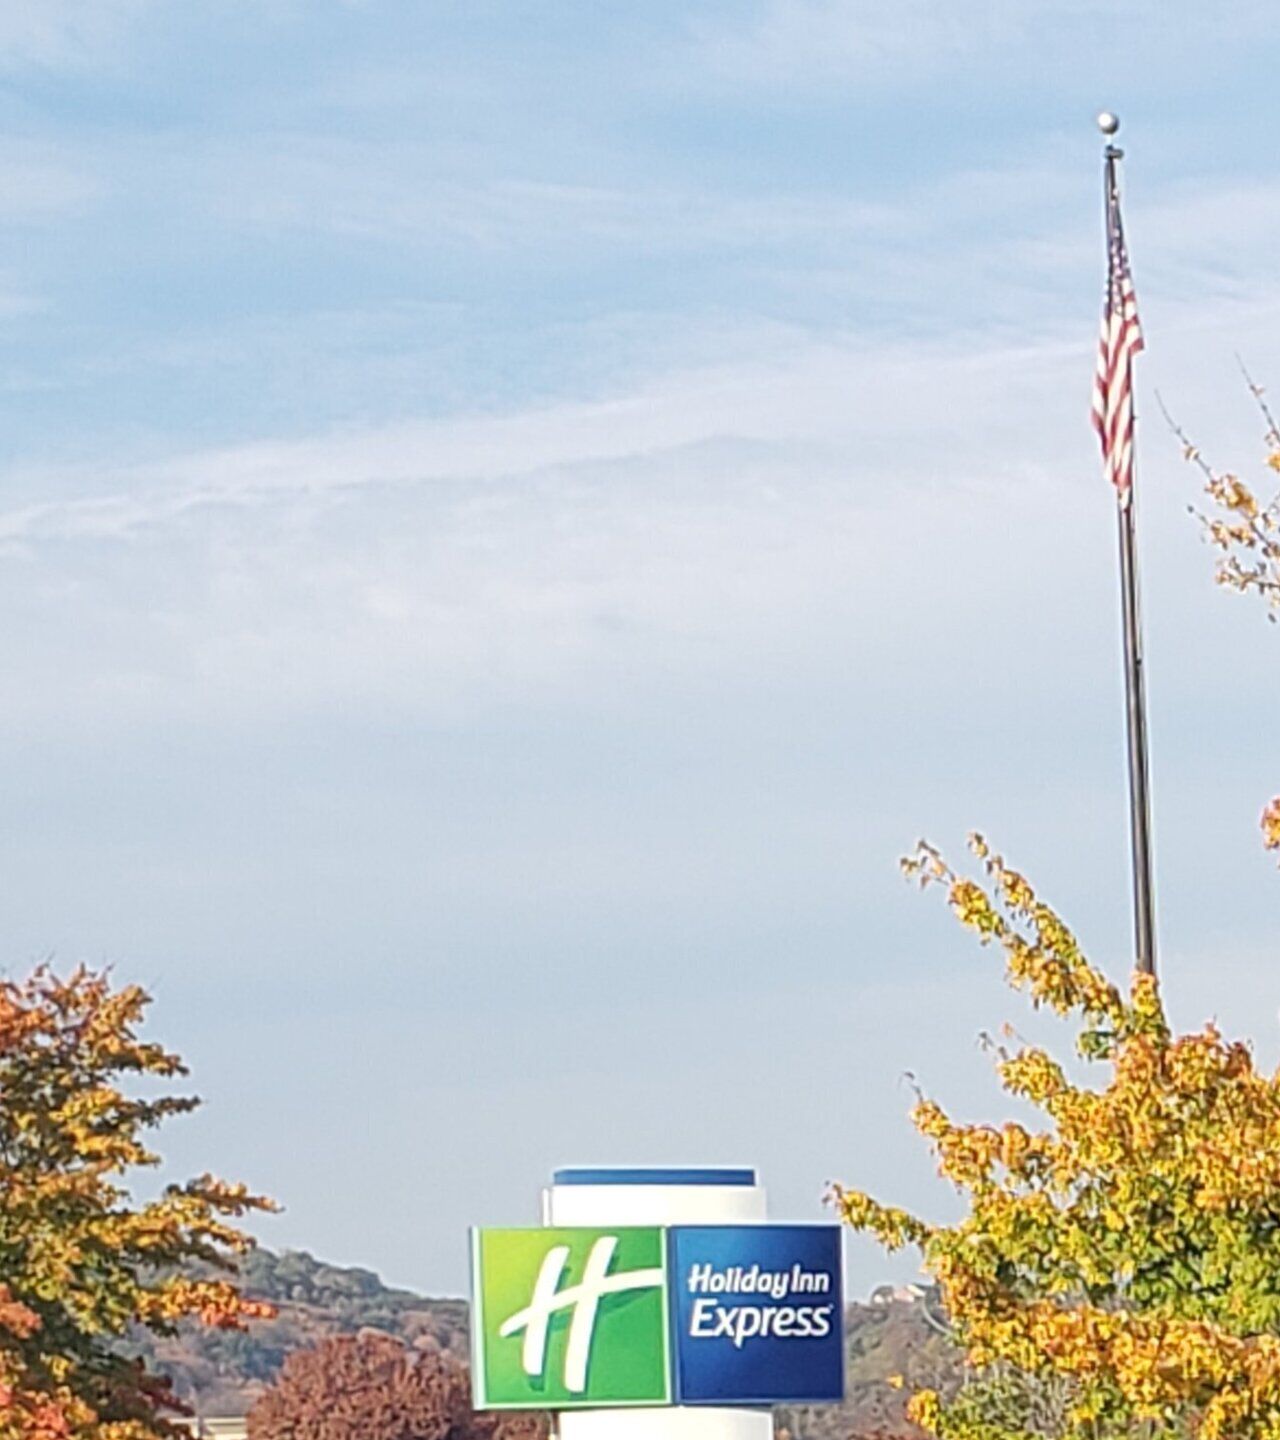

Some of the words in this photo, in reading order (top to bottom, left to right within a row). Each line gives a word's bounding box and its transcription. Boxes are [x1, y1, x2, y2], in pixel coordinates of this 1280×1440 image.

[688, 1263, 789, 1299] Holiday
[791, 1263, 830, 1293] Inn
[690, 1298, 831, 1348] Express
